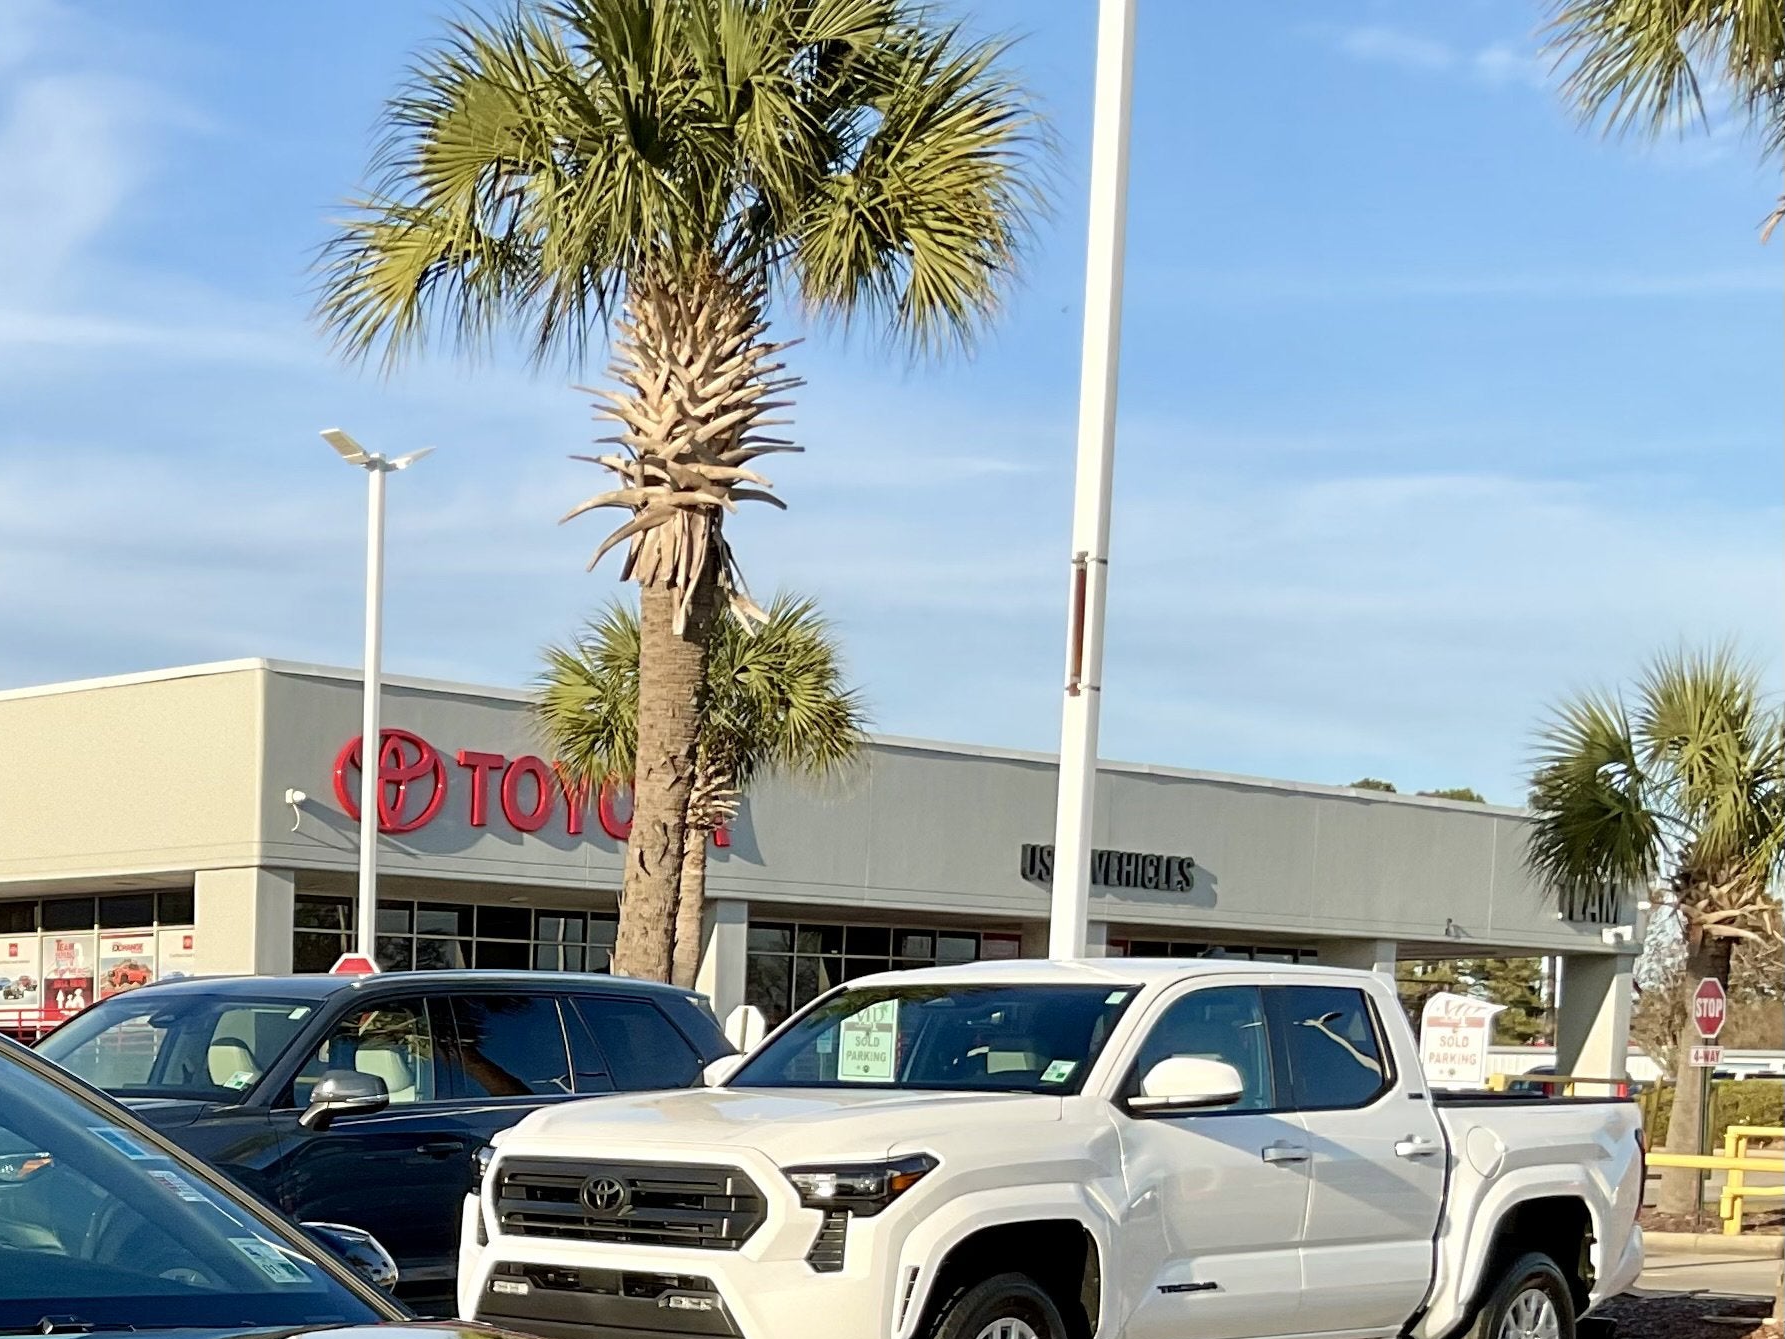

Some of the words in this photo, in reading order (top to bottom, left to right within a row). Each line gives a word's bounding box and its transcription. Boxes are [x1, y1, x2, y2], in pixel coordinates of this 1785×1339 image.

[1091, 849, 1195, 892] VEHICLES
[1695, 998, 1724, 1018] STOP
[855, 1036, 880, 1048] SOLD
[1439, 1035, 1469, 1048] SOLD
[846, 1050, 887, 1063] PARKING
[1428, 1052, 1477, 1066] PARKING
[1693, 1049, 1721, 1063] 4-WAY
